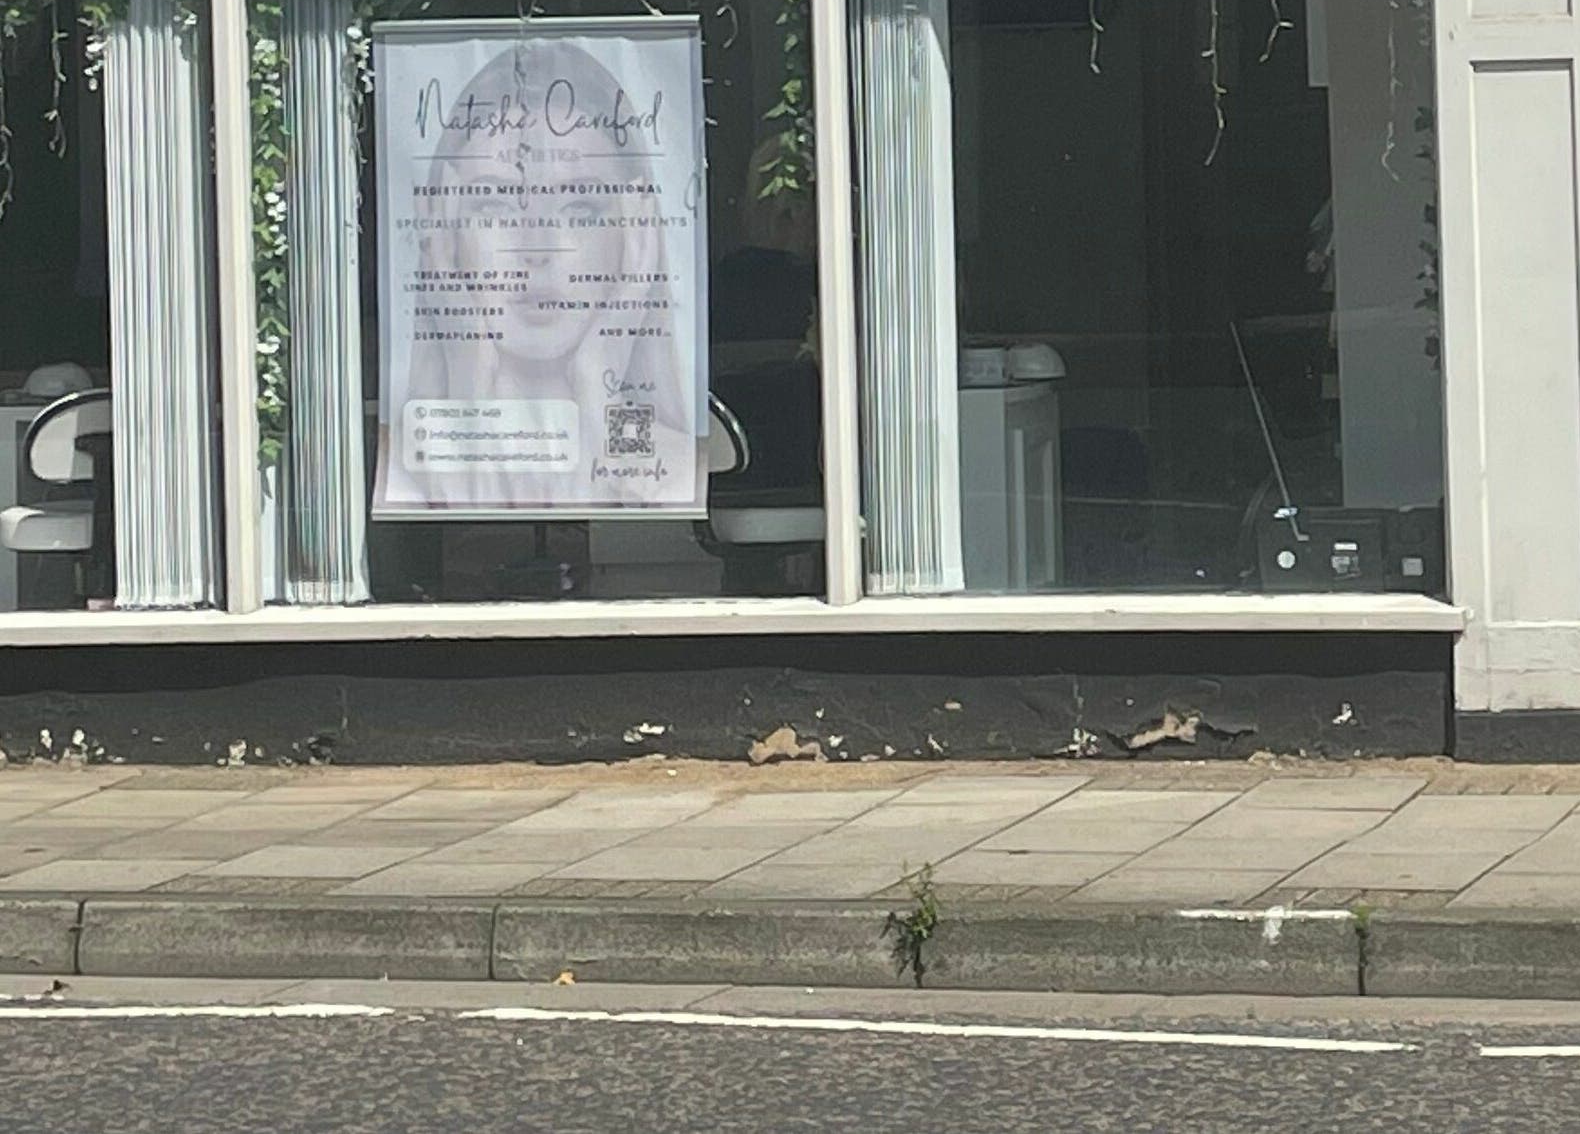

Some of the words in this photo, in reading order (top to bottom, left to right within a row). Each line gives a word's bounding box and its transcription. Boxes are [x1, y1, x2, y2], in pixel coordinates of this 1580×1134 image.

[415, 78, 537, 140] Natasha
[413, 186, 491, 196] REGISTERED
[561, 184, 662, 195] PROFESSIONAL
[500, 218, 561, 228] NATURAL
[568, 216, 687, 227] ENHANCEMENTS
[569, 274, 617, 283] DERMAL
